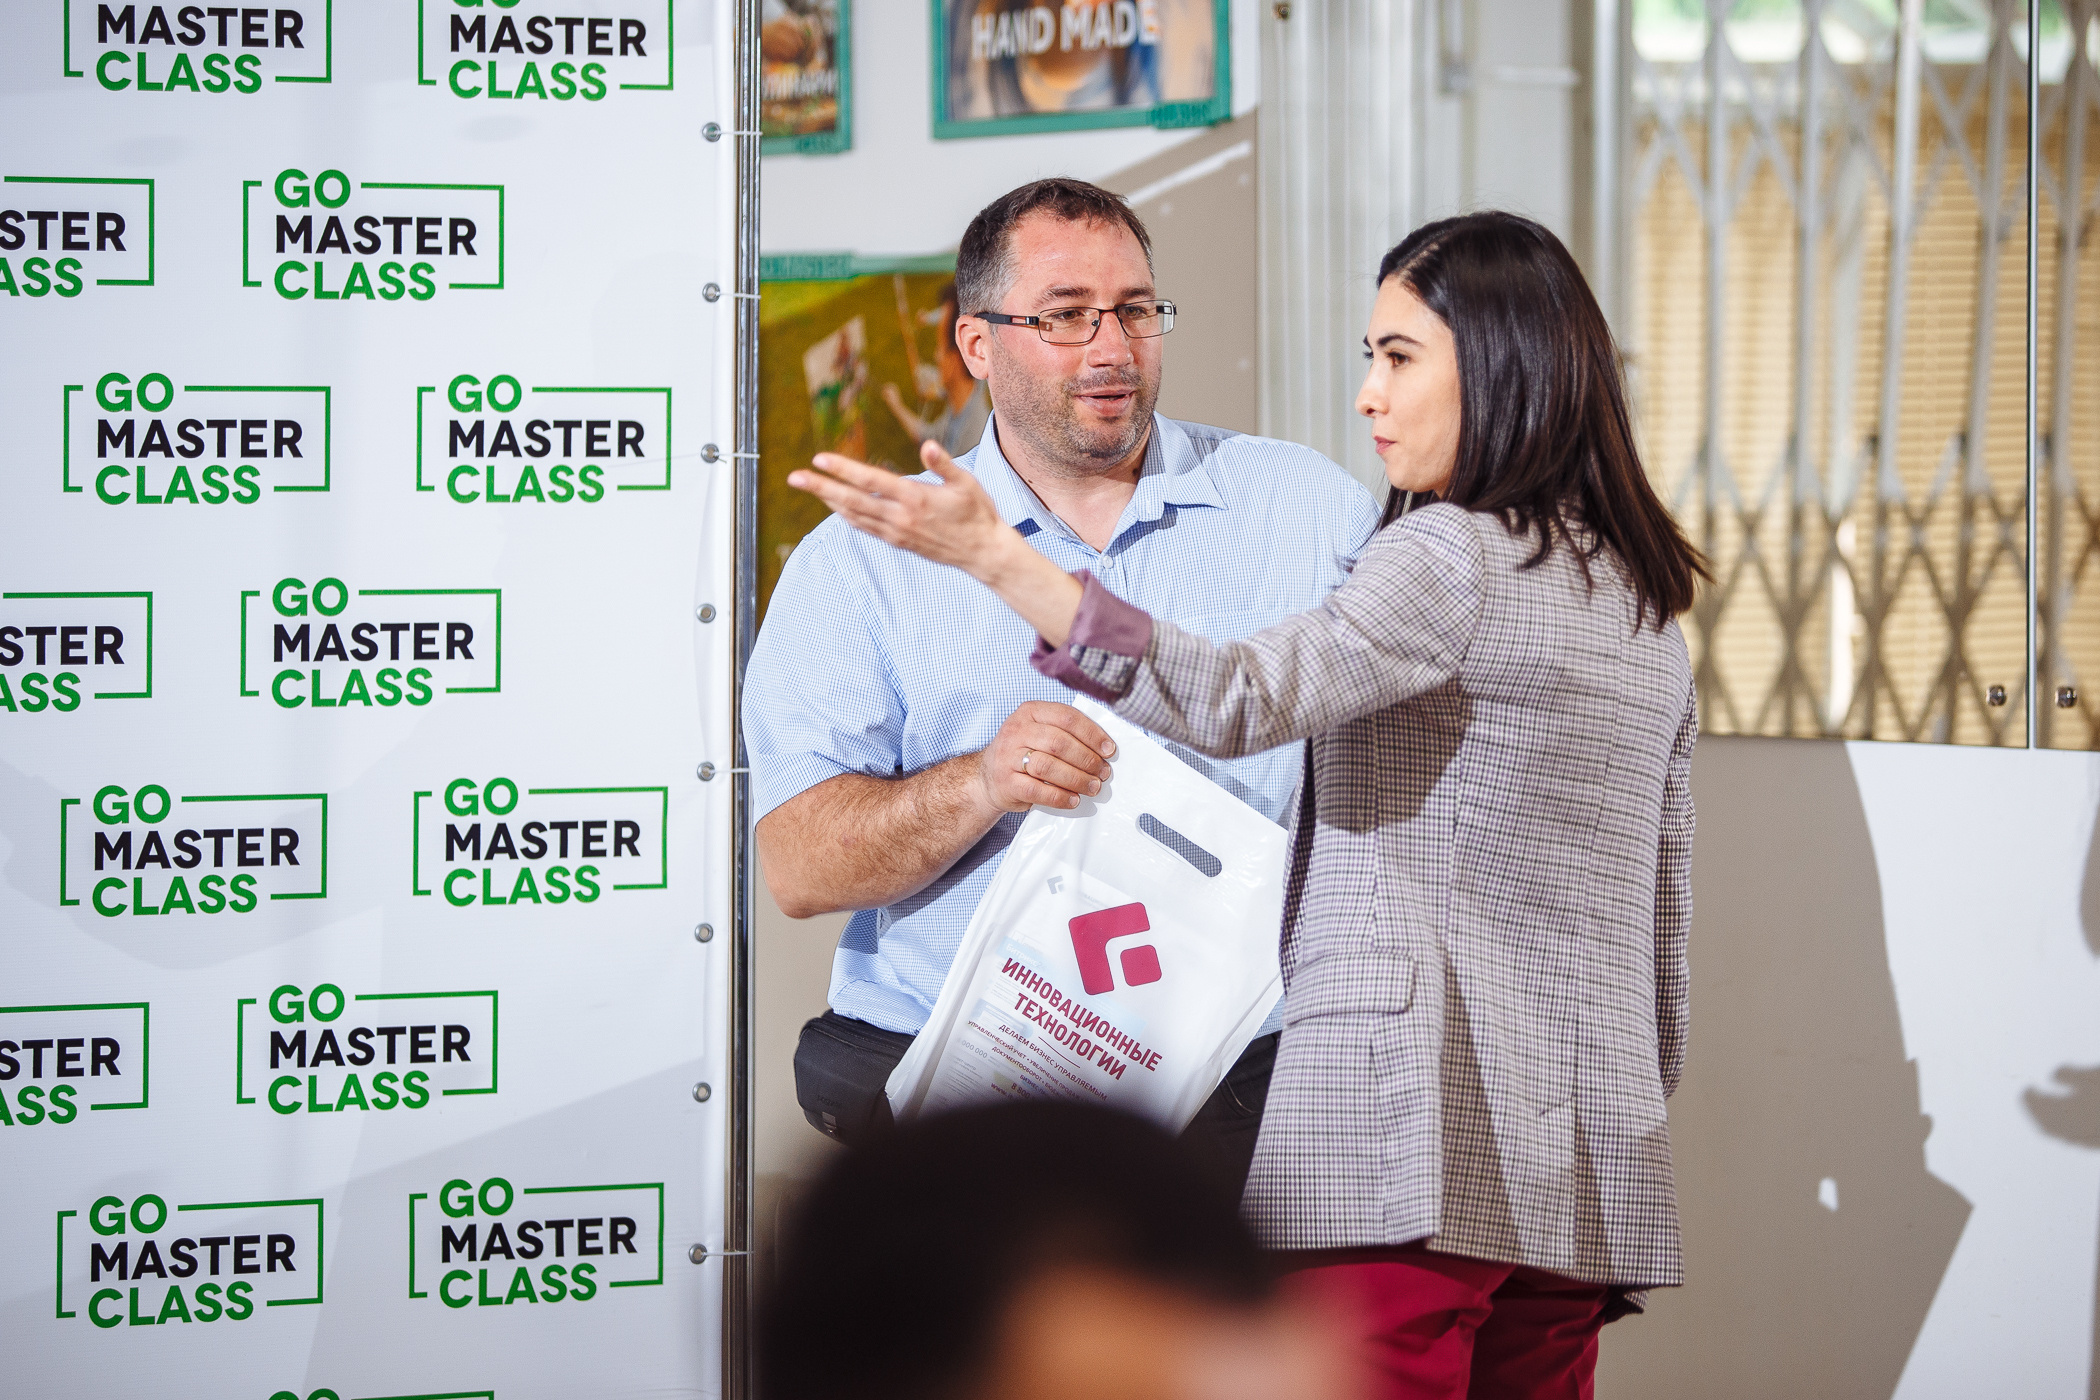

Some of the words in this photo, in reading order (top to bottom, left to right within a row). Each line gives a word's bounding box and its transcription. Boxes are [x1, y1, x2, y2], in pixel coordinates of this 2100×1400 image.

[97, 4, 305, 49] MASTER
[450, 14, 647, 57] MASTER
[970, 6, 1055, 60] HAND
[1060, 0, 1159, 52] MADE
[96, 51, 262, 94] CLASS
[448, 60, 607, 101] CLASS
[274, 168, 351, 209] GO
[0, 209, 127, 252] STER
[276, 215, 477, 256] MASTER
[274, 261, 436, 301] CLASS
[95, 372, 174, 413] GO
[447, 374, 522, 413] GO
[97, 418, 303, 459] MASTER
[449, 419, 645, 458] MASTER
[95, 464, 261, 505] CLASS
[446, 464, 605, 504] CLASS
[272, 577, 349, 617] GO
[0, 625, 125, 667] STER
[273, 622, 475, 663] MASTER
[271, 667, 433, 709] CLASS
[92, 784, 171, 825] GO
[444, 777, 519, 817] GO
[94, 827, 300, 871] MASTER
[445, 820, 641, 862] MASTER
[92, 873, 258, 917] CLASS
[443, 865, 601, 907] CLASS
[268, 983, 345, 1024] GO
[1001, 957, 1163, 1072] ИННОВАЦИОННЫЕ
[270, 1024, 471, 1070] MASTER
[967, 1020, 1014, 1052] УПРАВЛЕНЧЕСКИЙ
[1013, 1048, 1027, 1060] УЧЕТ
[1029, 1059, 1059, 1086] УВЕЛИЧЕНИЕ
[1013, 993, 1127, 1080] ТЕХНОЛОГИИ
[0, 1037, 121, 1081] STER
[991, 1046, 1042, 1082] ДОКУМЕНТООБОРОТ
[998, 1024, 1029, 1046] ДЕЛАЕМ
[1029, 1043, 1054, 1066] БИЗНЕС
[1054, 1062, 1108, 1101] УПРАВЛЯЕМЫМ
[267, 1070, 430, 1115] CLASS
[1011, 1082, 1017, 1090] 8
[89, 1194, 167, 1236] GO
[439, 1177, 514, 1219] GO
[90, 1233, 296, 1283] MASTER
[441, 1216, 638, 1264] MASTER
[88, 1281, 254, 1329] CLASS
[439, 1263, 597, 1309] CLASS
